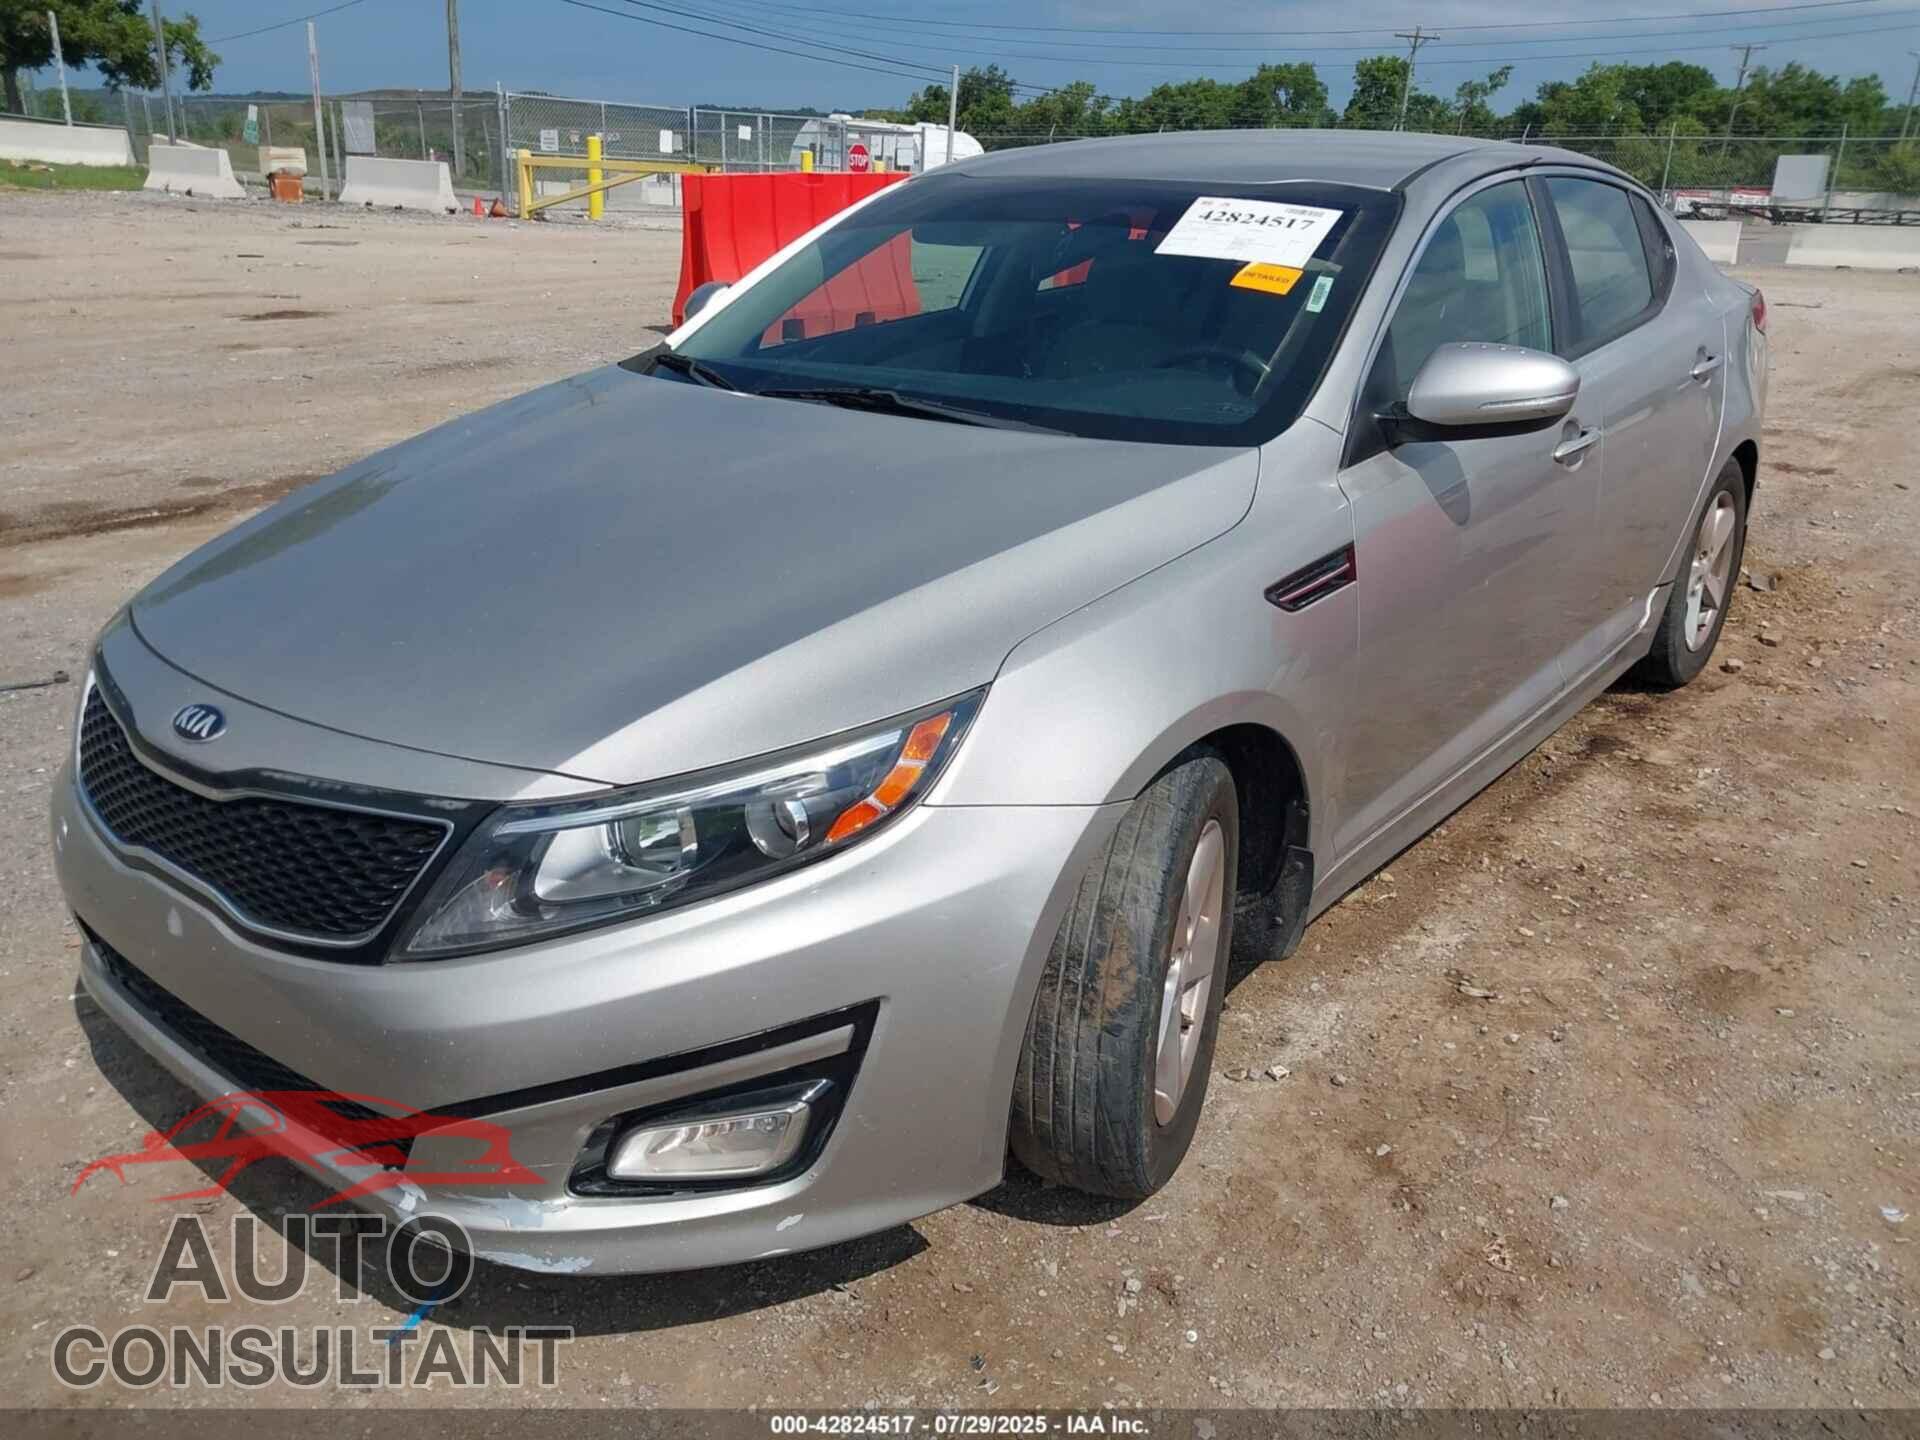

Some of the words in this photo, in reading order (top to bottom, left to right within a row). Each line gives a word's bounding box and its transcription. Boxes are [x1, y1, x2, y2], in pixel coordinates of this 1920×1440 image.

[850, 154, 868, 168] STOP
[1198, 210, 1316, 230] 42824517
[175, 706, 217, 737] KIA
